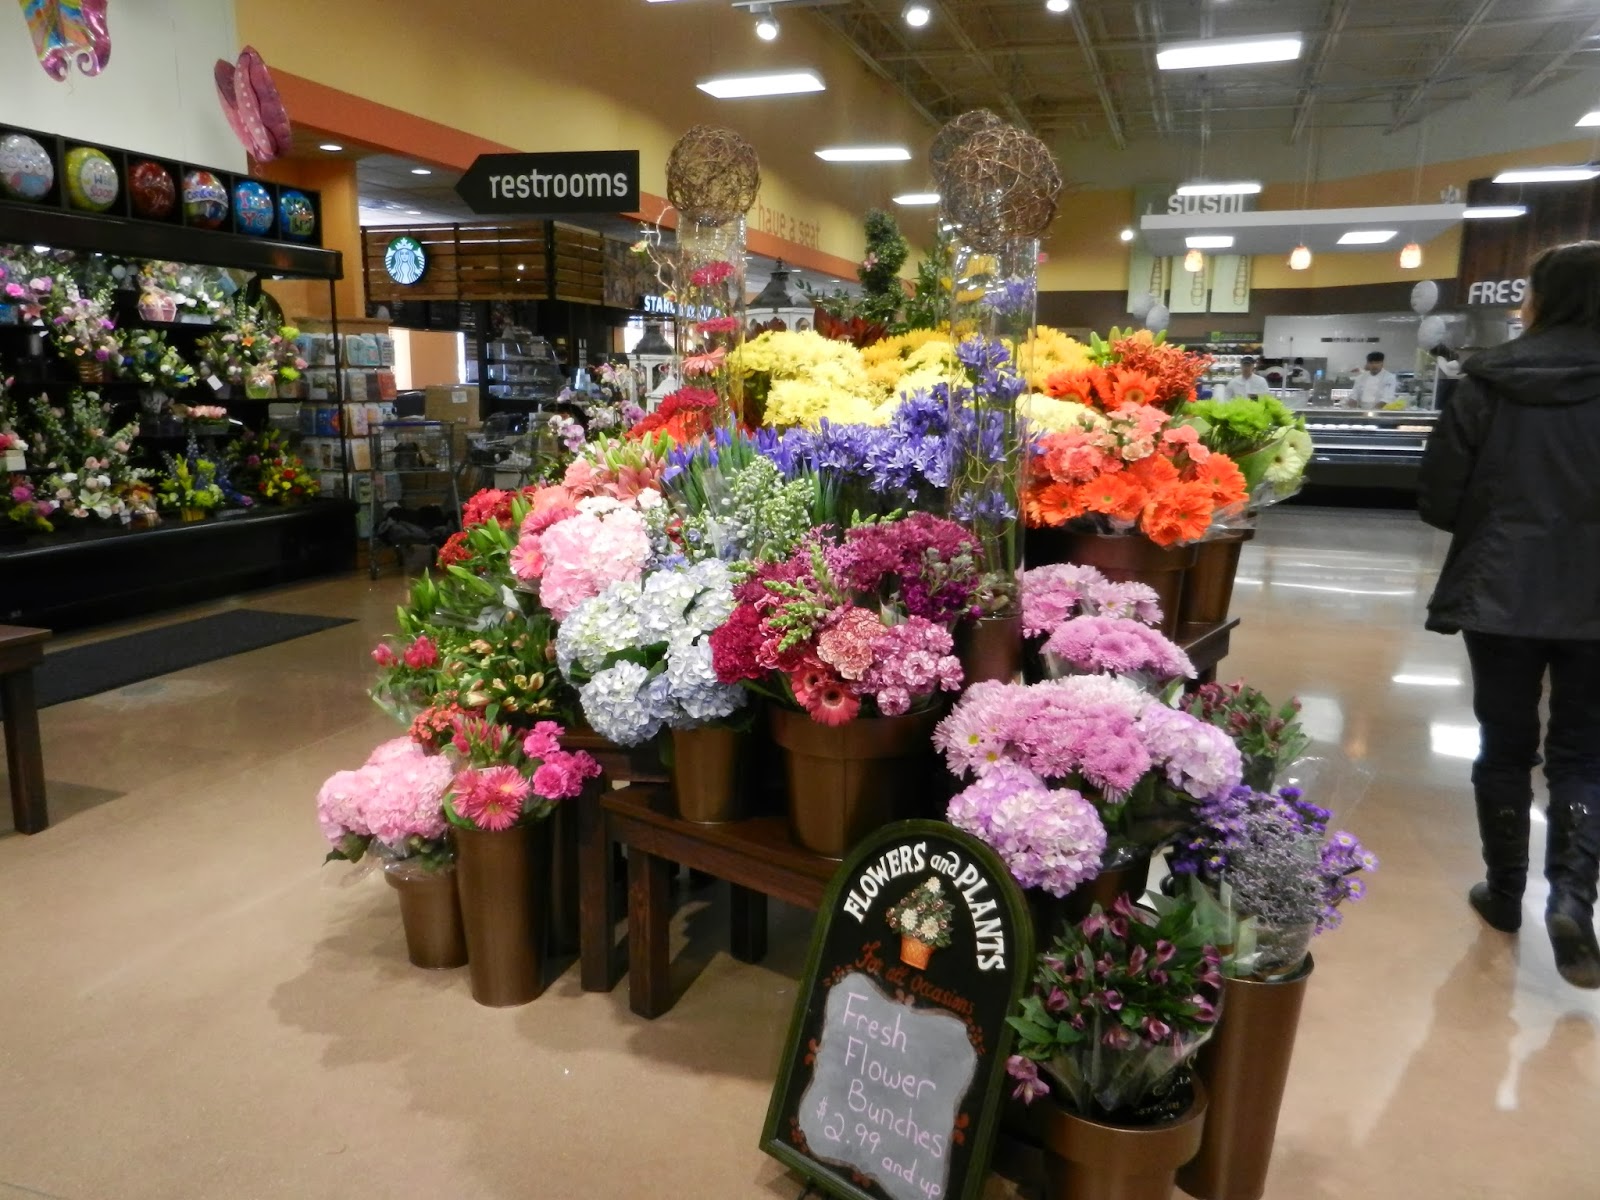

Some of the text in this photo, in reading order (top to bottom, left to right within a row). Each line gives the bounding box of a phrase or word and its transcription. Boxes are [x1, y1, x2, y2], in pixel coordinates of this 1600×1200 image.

[489, 169, 628, 198] restrooms
[1467, 278, 1527, 305] FRES
[843, 841, 1006, 972] FLOWERS and PLANTS
[843, 992, 907, 1053] Fresh
[845, 1035, 937, 1099] Flower
[848, 1079, 943, 1158] Bunches
[882, 1157, 942, 1199] and up
